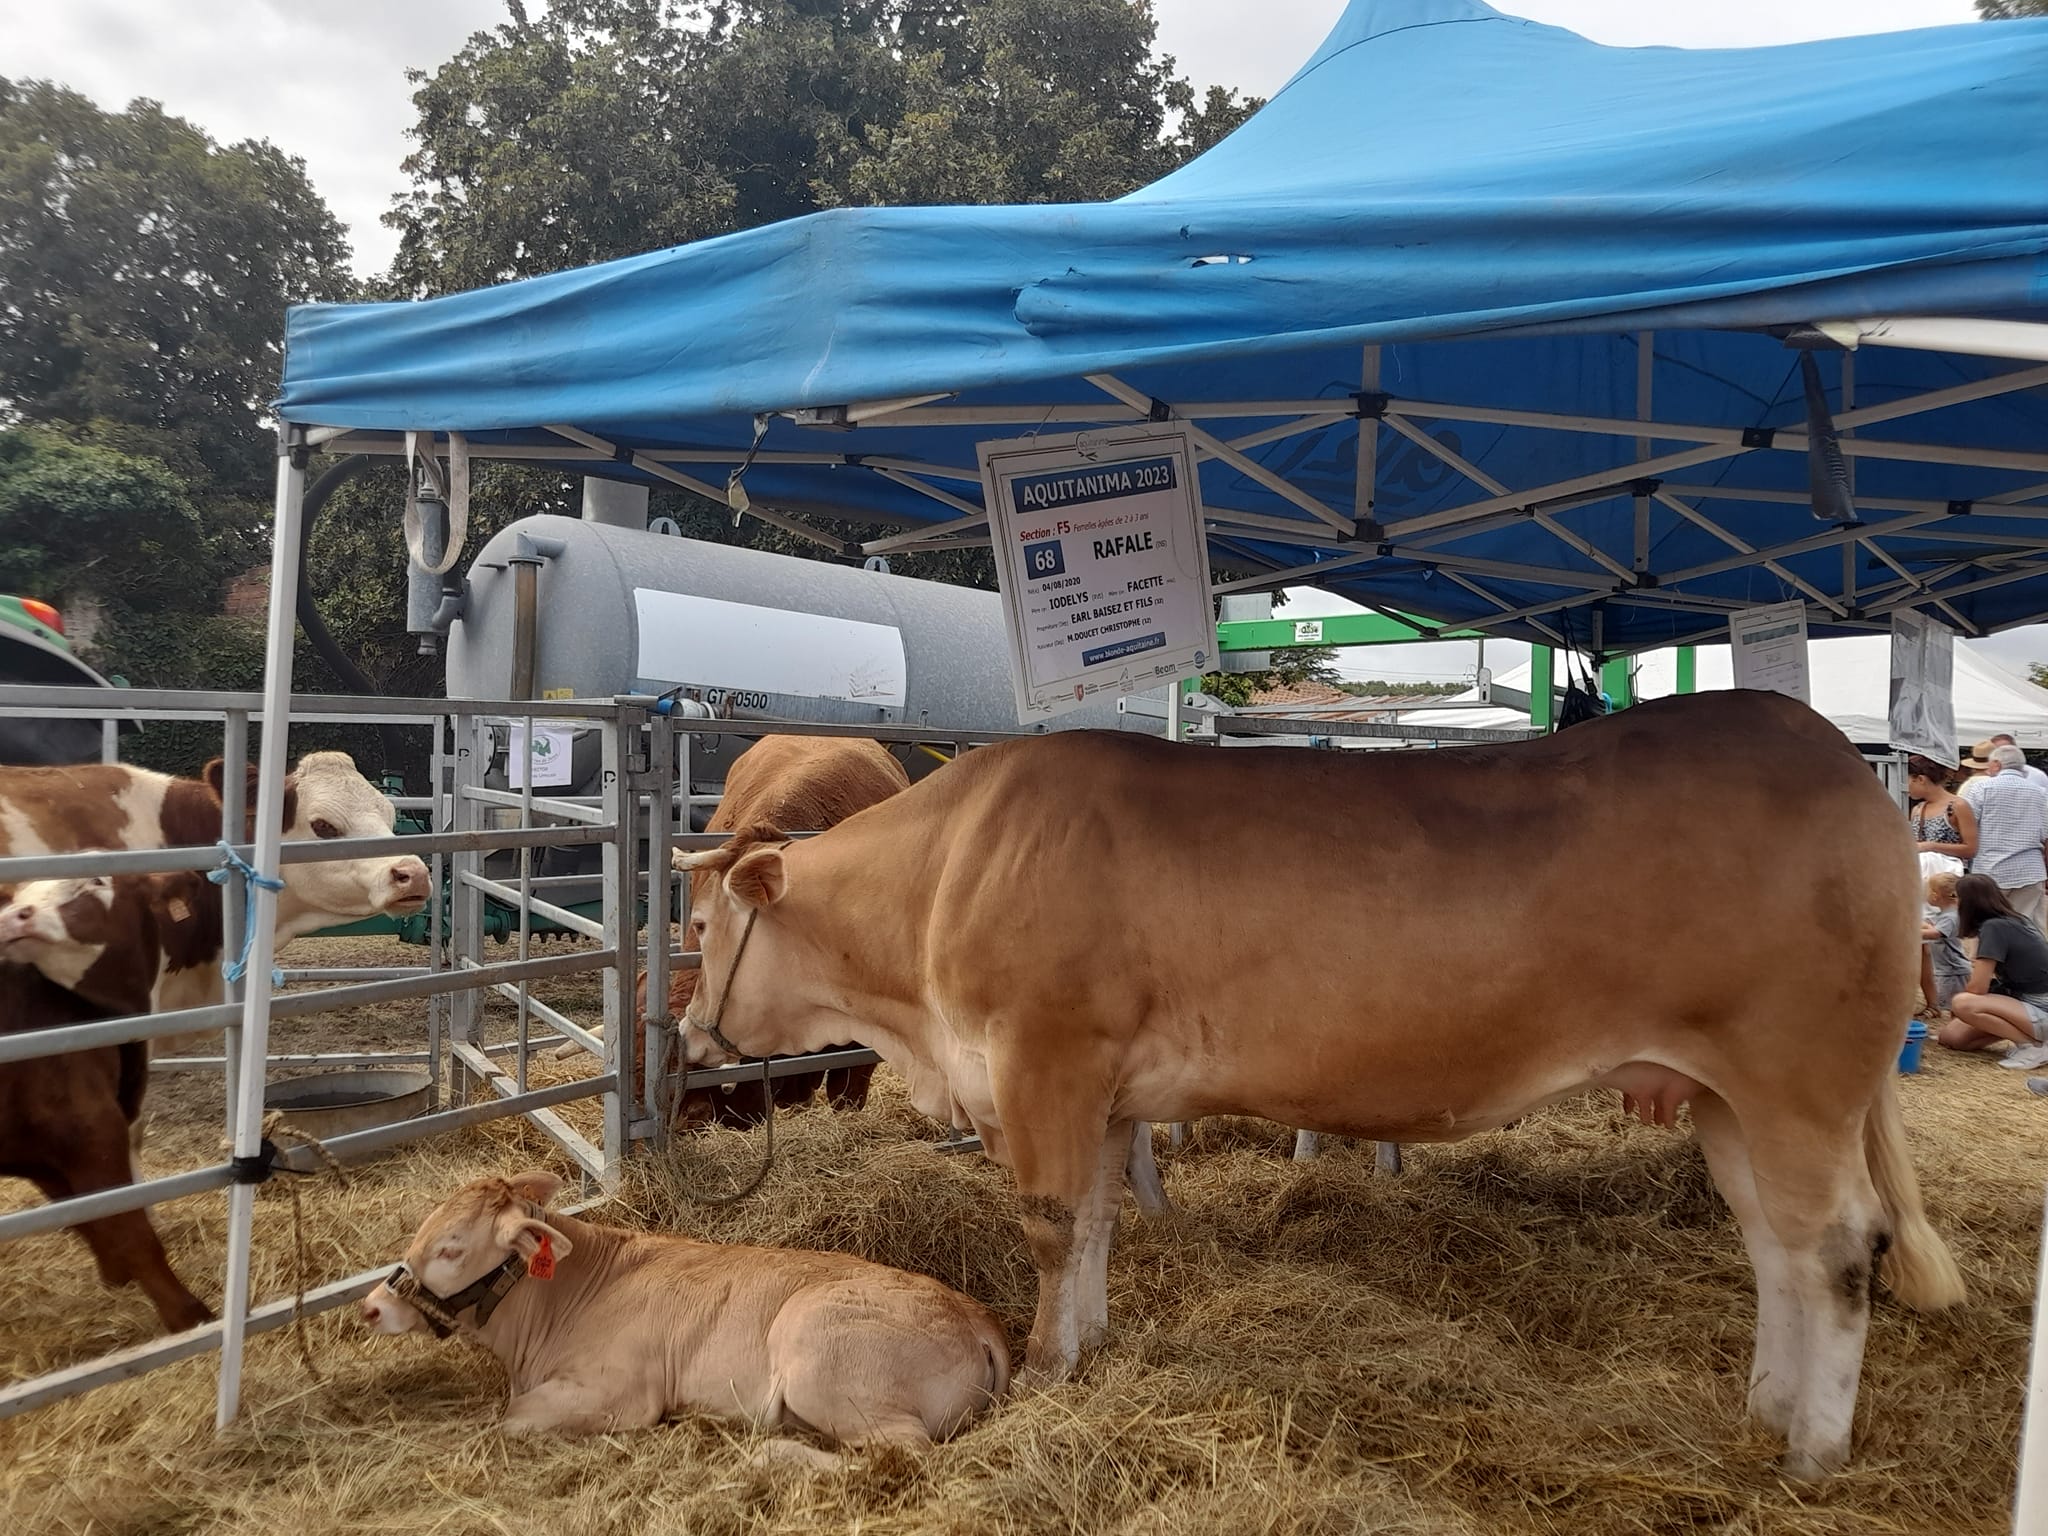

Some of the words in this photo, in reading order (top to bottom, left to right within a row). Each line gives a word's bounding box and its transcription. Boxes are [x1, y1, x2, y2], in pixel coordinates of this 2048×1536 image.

[1023, 471, 1132, 507] AQUITANIMA
[1135, 465, 1170, 488] 2023
[1020, 527, 1051, 542] Section
[1093, 531, 1154, 560] RAFALE
[1034, 549, 1056, 572] 68
[1042, 576, 1081, 592] 04/08/2020
[1127, 575, 1164, 592] FACETTE
[1049, 591, 1089, 610] IODELYS
[1071, 610, 1092, 624] EARL
[1093, 603, 1122, 619] BAISEZ
[1123, 600, 1134, 612] ET
[1135, 596, 1153, 609] FILS
[1100, 617, 1141, 634] CHRISTOPHE
[707, 688, 727, 705] GT
